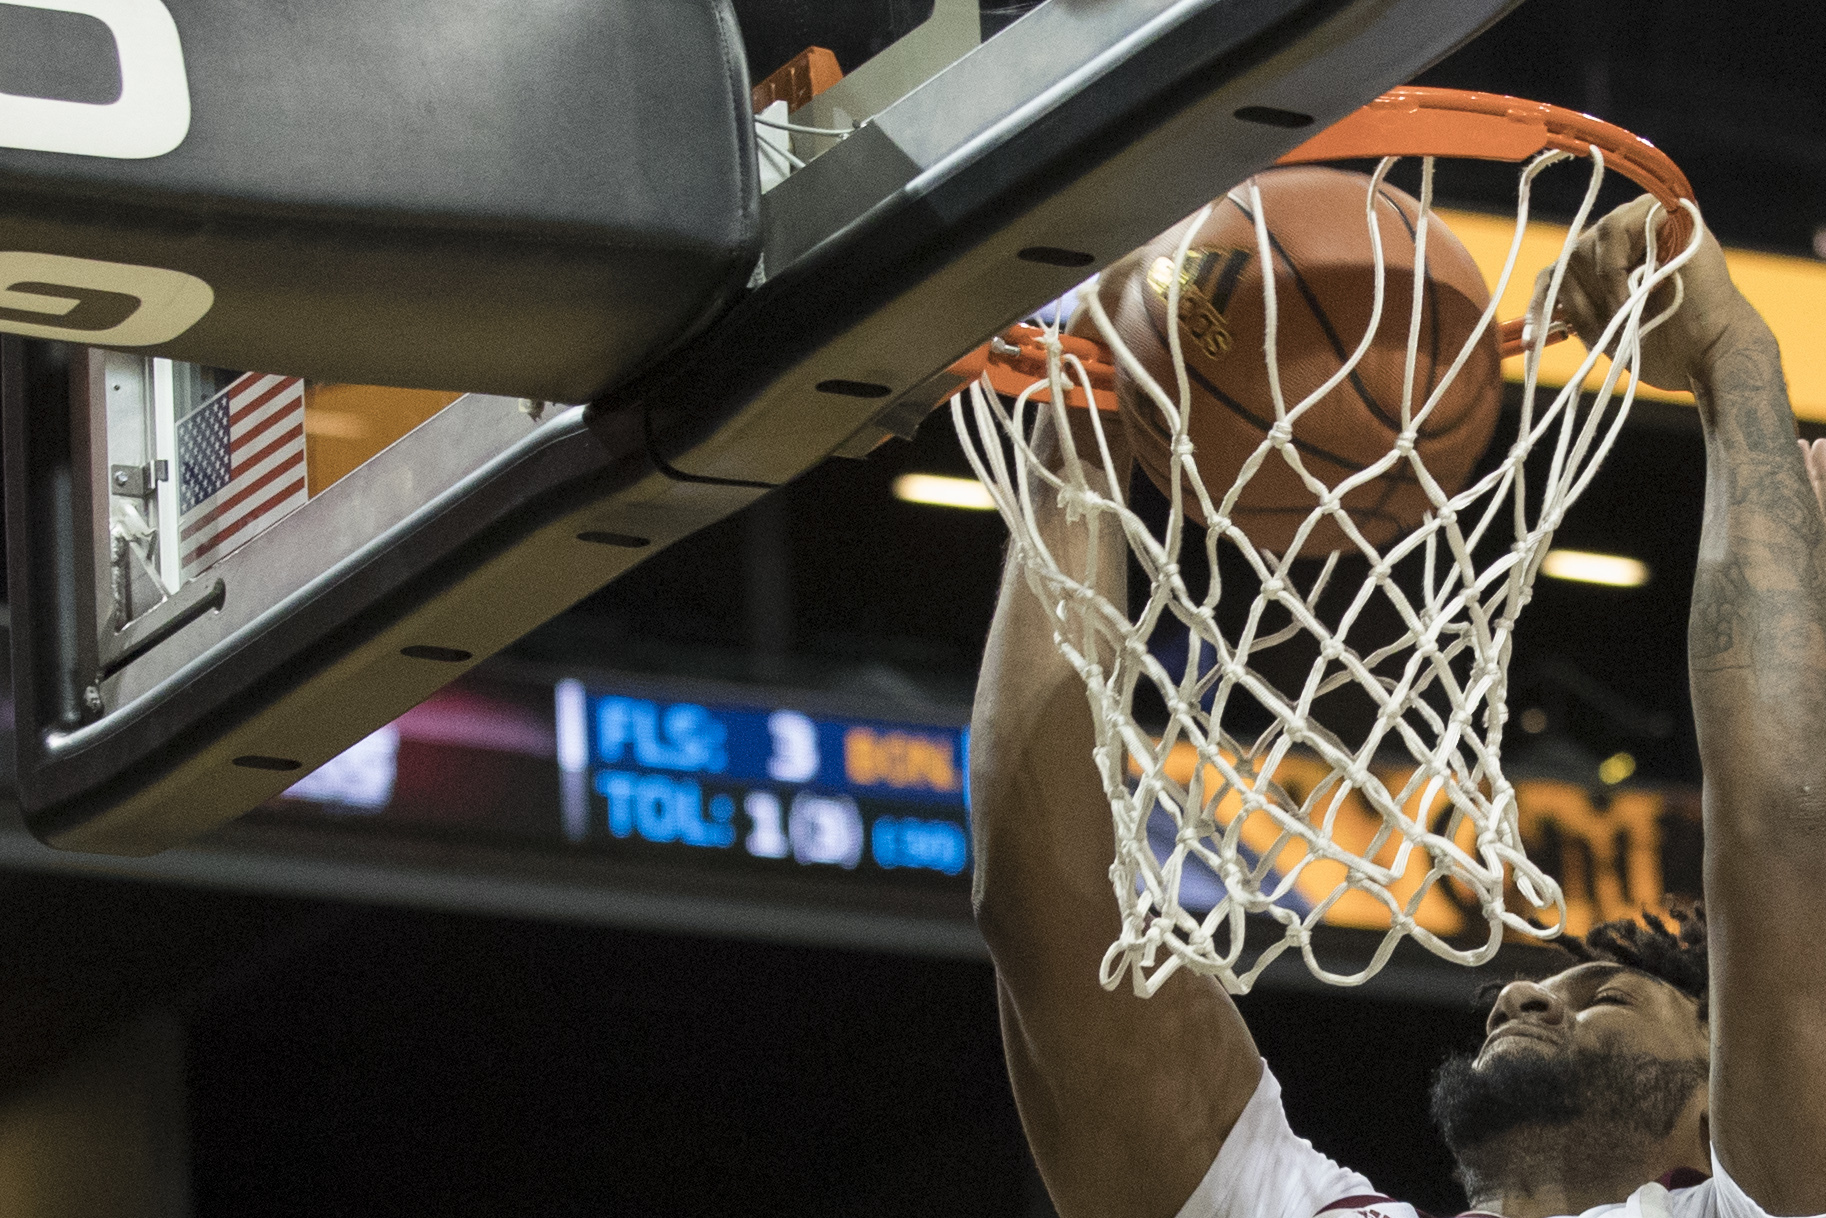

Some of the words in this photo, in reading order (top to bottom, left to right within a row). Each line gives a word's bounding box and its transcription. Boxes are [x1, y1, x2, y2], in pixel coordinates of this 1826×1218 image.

[600, 697, 727, 772] FLS:
[769, 711, 819, 782] 3
[598, 771, 735, 847] TOL:
